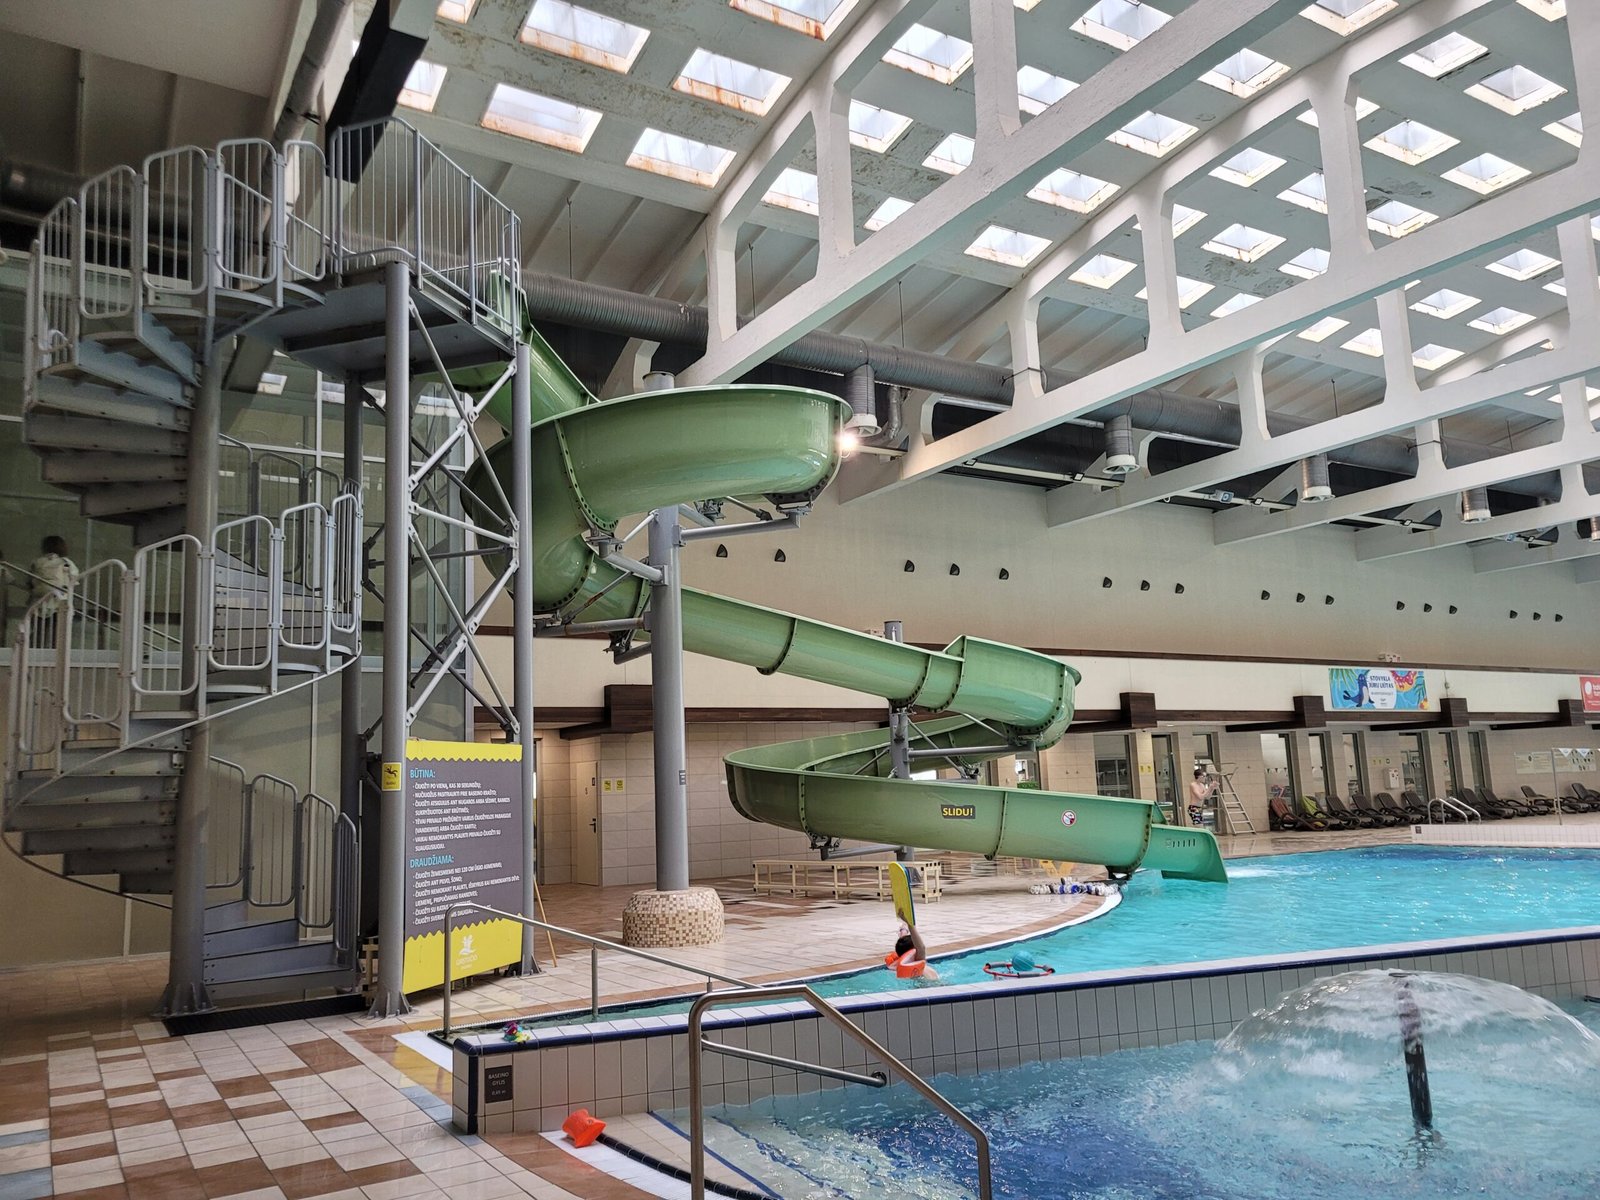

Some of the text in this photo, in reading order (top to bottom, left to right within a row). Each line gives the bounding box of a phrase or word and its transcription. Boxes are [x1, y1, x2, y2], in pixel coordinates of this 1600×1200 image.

[410, 768, 436, 778] BŪTINA:
[942, 807, 973, 817] SLIDU!
[410, 855, 454, 868] DRAUDŽIAMA:
